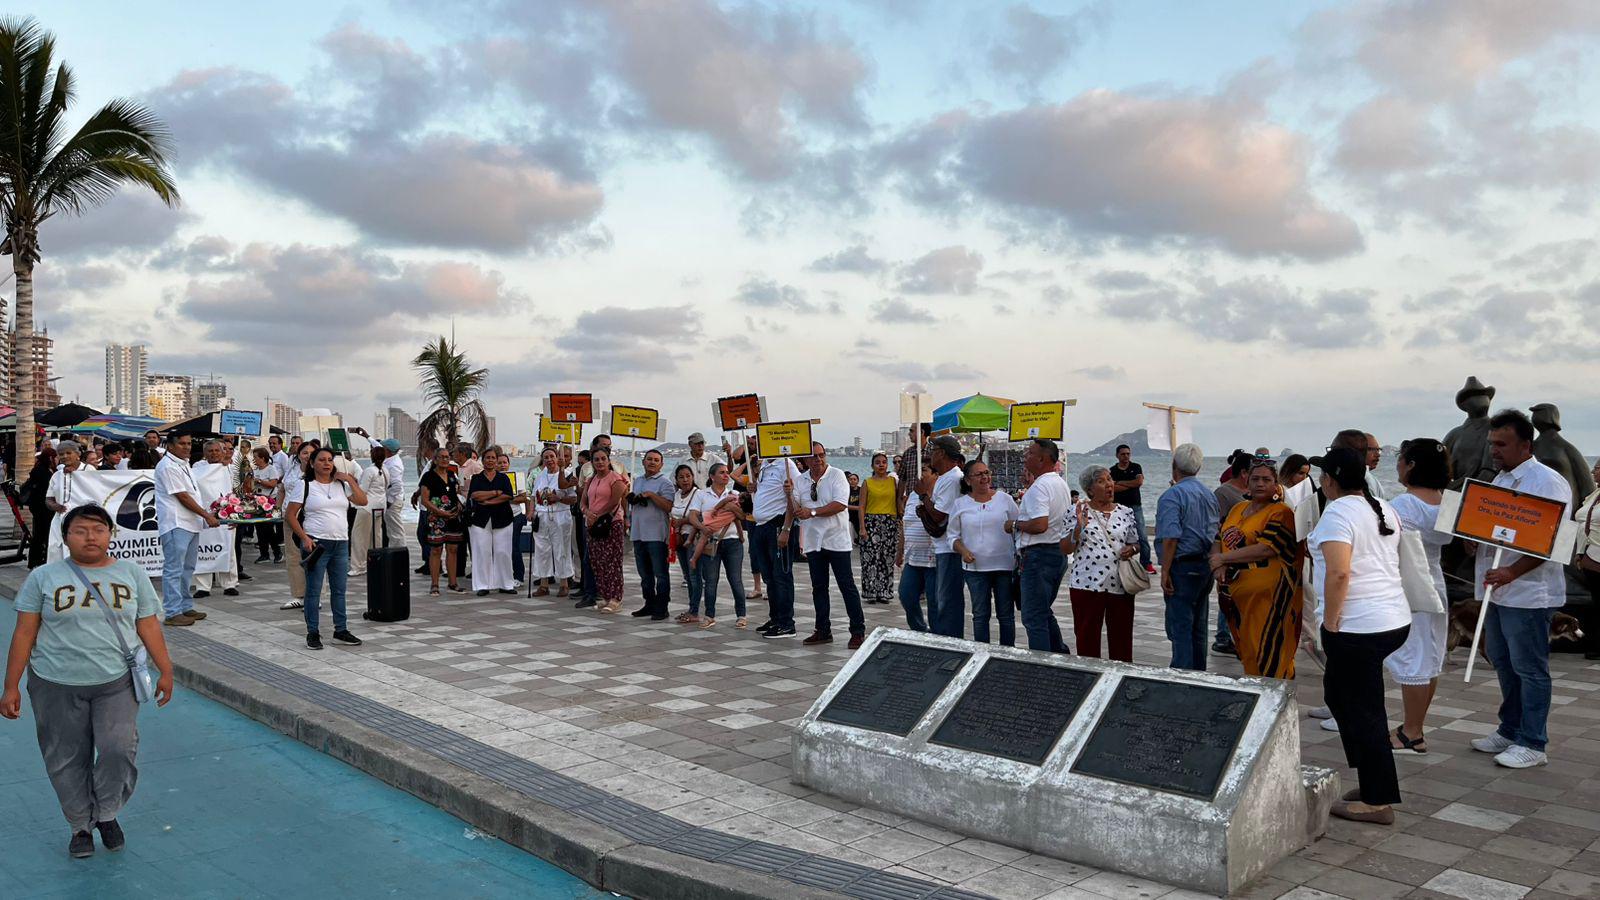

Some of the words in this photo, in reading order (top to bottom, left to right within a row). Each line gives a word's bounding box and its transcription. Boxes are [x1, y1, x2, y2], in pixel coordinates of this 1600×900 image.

[1501, 510, 1513, 520] Paz
[106, 547, 160, 559] MONIAL
[54, 582, 131, 613] GAP
